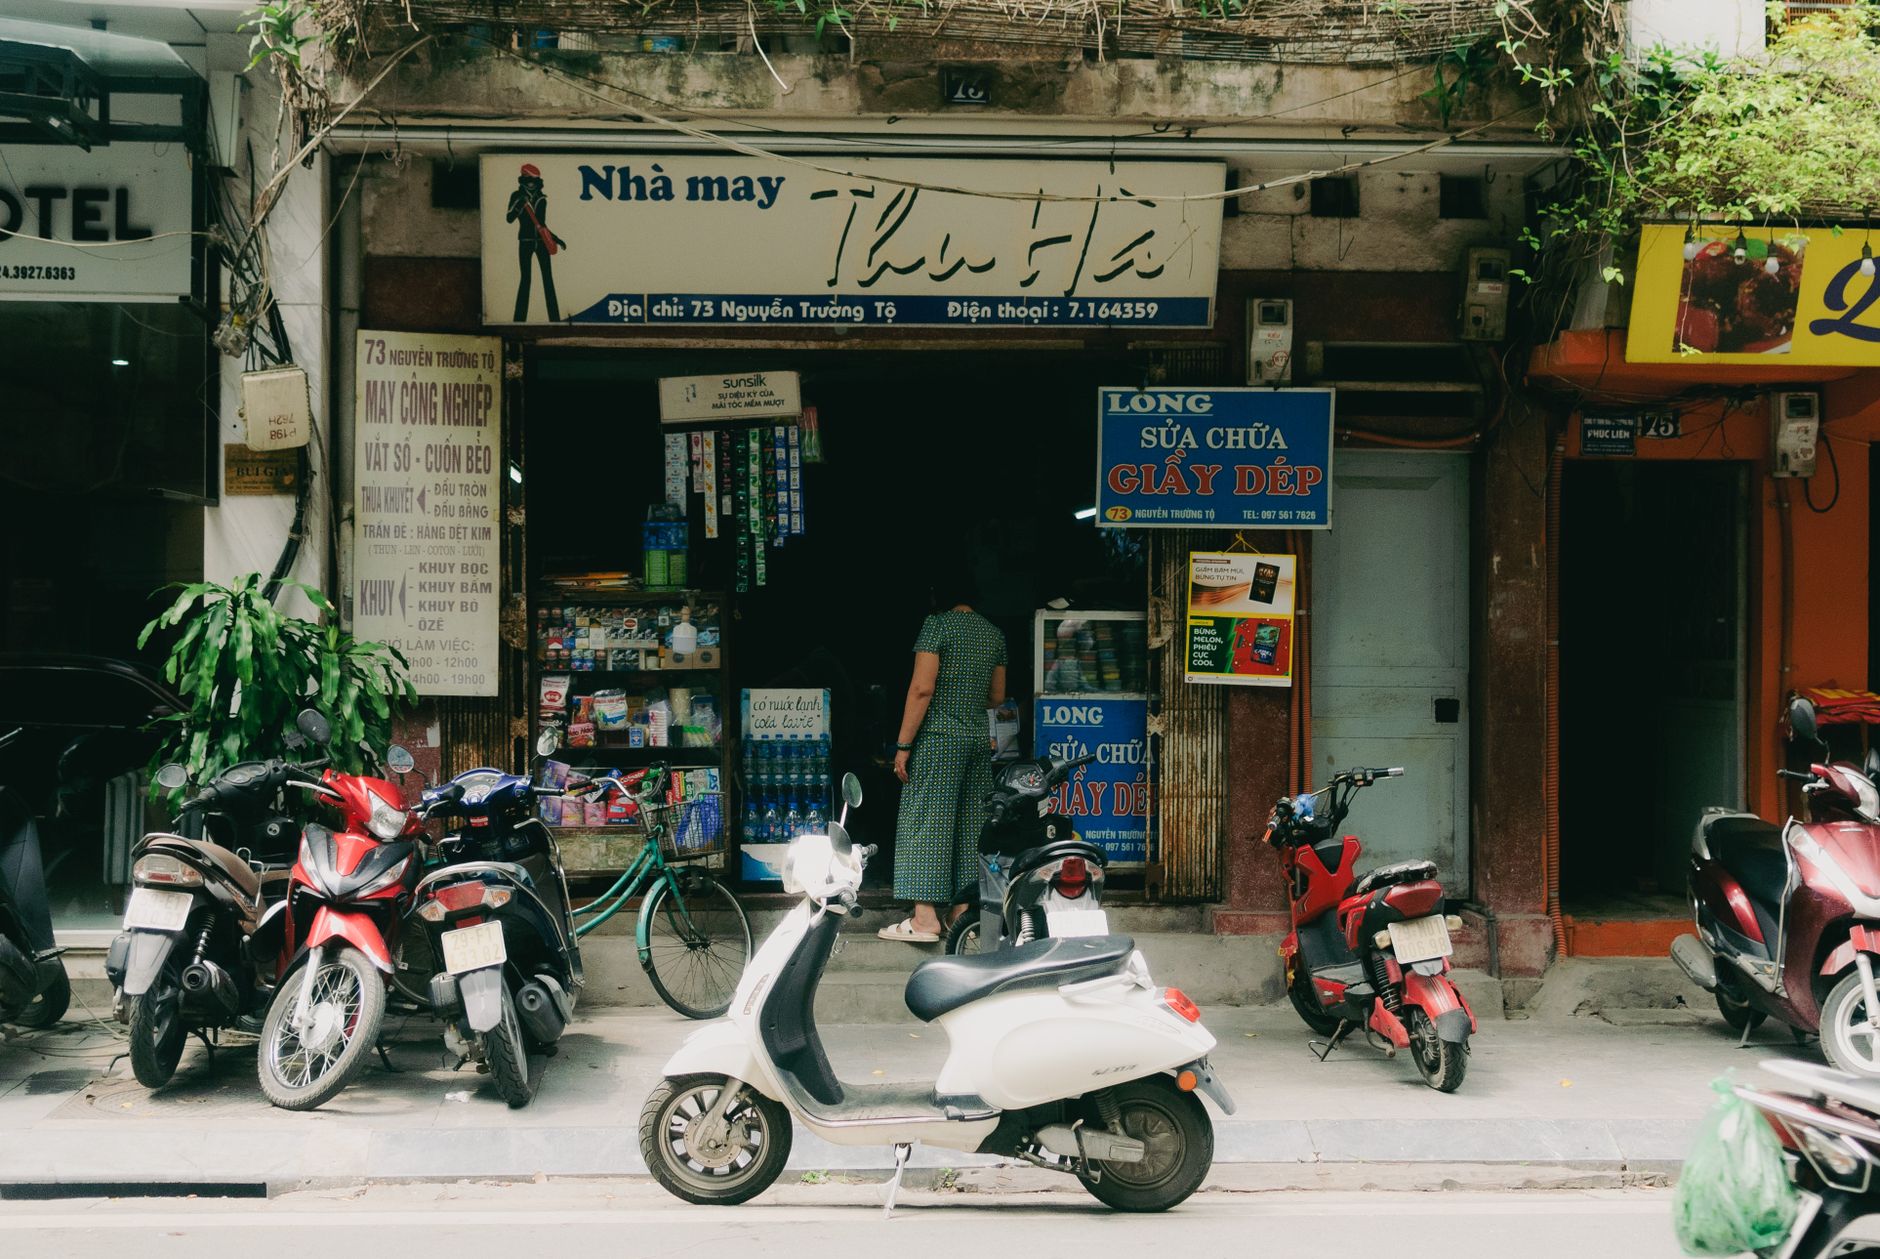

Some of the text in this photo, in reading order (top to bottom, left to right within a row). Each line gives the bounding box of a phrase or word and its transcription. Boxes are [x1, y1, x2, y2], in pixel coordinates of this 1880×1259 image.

[578, 163, 786, 210] Nhà may
[811, 184, 1164, 298] Thu Hà
[0, 264, 76, 280] 4.3927.6363
[608, 297, 1159, 323] Địa chỉ: 73 Nguyễn Trường Tộ Điện thoại 7.164359
[365, 339, 495, 373] 73 NGUYỄN TRƯỜNG TỘ
[723, 374, 767, 388] sunsilk
[365, 371, 493, 430] MAY CÔNG NGHIỆP
[1108, 394, 1214, 413] LONG
[1141, 418, 1288, 449] SỬA CHỮA
[1646, 416, 1674, 436] 75
[365, 432, 389, 472] VẮT
[394, 431, 411, 472] SỔ
[425, 433, 461, 473] CUỐN
[1108, 449, 1323, 496] GIẦY DÉP
[361, 480, 382, 513] THÙA
[460, 480, 487, 497] TRÒN
[1110, 508, 1128, 520] 73
[1135, 507, 1168, 520] NGUYỄN
[1170, 507, 1202, 520] TRƯỜNG
[1205, 508, 1215, 522] TỘ
[1243, 510, 1259, 520] TEL:
[1261, 510, 1276, 520] 097
[1278, 510, 1293, 520] 561
[417, 522, 446, 540] HÀNG
[449, 523, 468, 544] DỆT
[471, 527, 492, 540] KIM
[404, 545, 420, 555] LEN
[427, 546, 455, 556] COTON
[419, 562, 489, 577] KHUY BỌC
[419, 581, 455, 593] KHUY
[360, 580, 395, 616] KHUY
[418, 601, 455, 612] KHUY
[418, 617, 444, 631] ÔZÊ
[407, 636, 435, 651] LÀM
[440, 637, 475, 654] VIỆC:
[1193, 636, 1223, 644] MELON,
[445, 657, 478, 668] 12h00
[407, 674, 439, 684] 14h00
[452, 674, 485, 685] 19h00
[753, 696, 768, 711] có
[796, 696, 823, 714] lạnh
[1043, 706, 1103, 724] LONG
[1105, 842, 1119, 851] 097
[1121, 842, 1134, 851] 561
